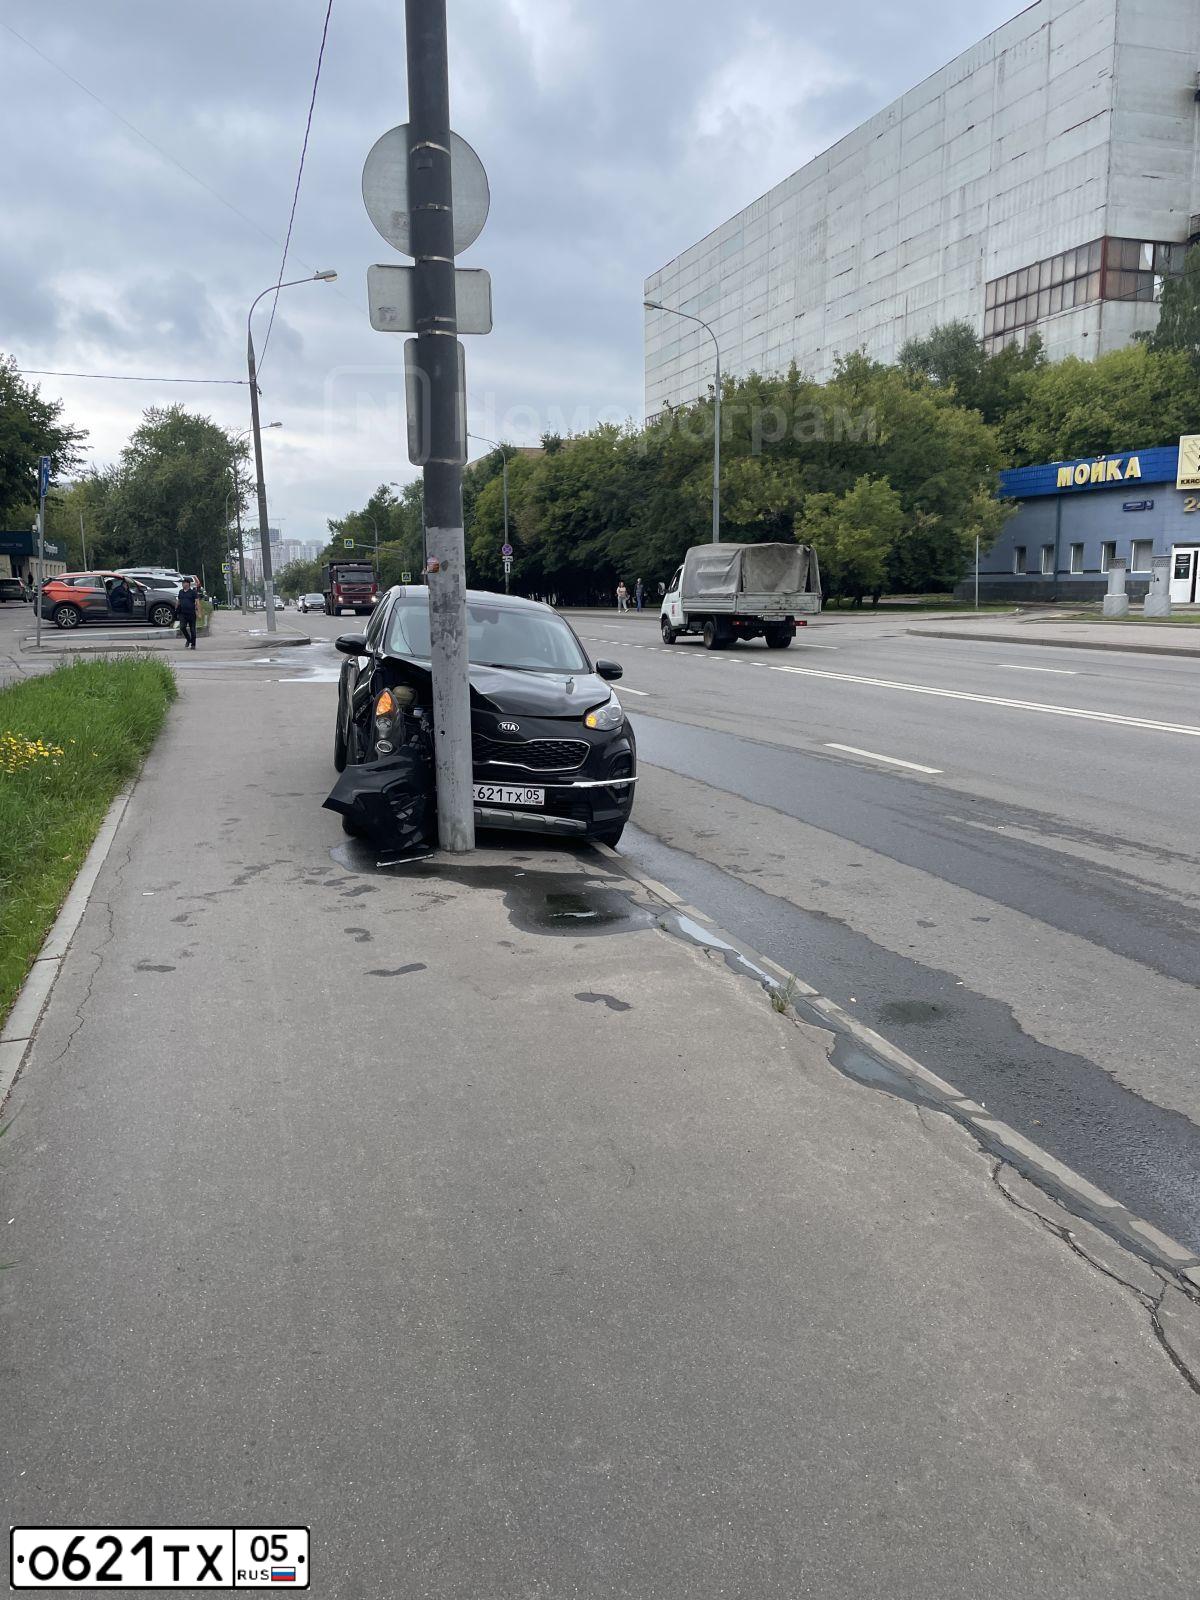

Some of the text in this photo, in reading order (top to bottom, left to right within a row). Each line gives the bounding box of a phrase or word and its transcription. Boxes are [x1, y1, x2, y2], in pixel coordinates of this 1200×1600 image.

[1056, 455, 1142, 488] МОЙКА
[1183, 496, 1200, 513] 2
[501, 723, 516, 731] KIA
[473, 786, 540, 803] 621ТХ 05
